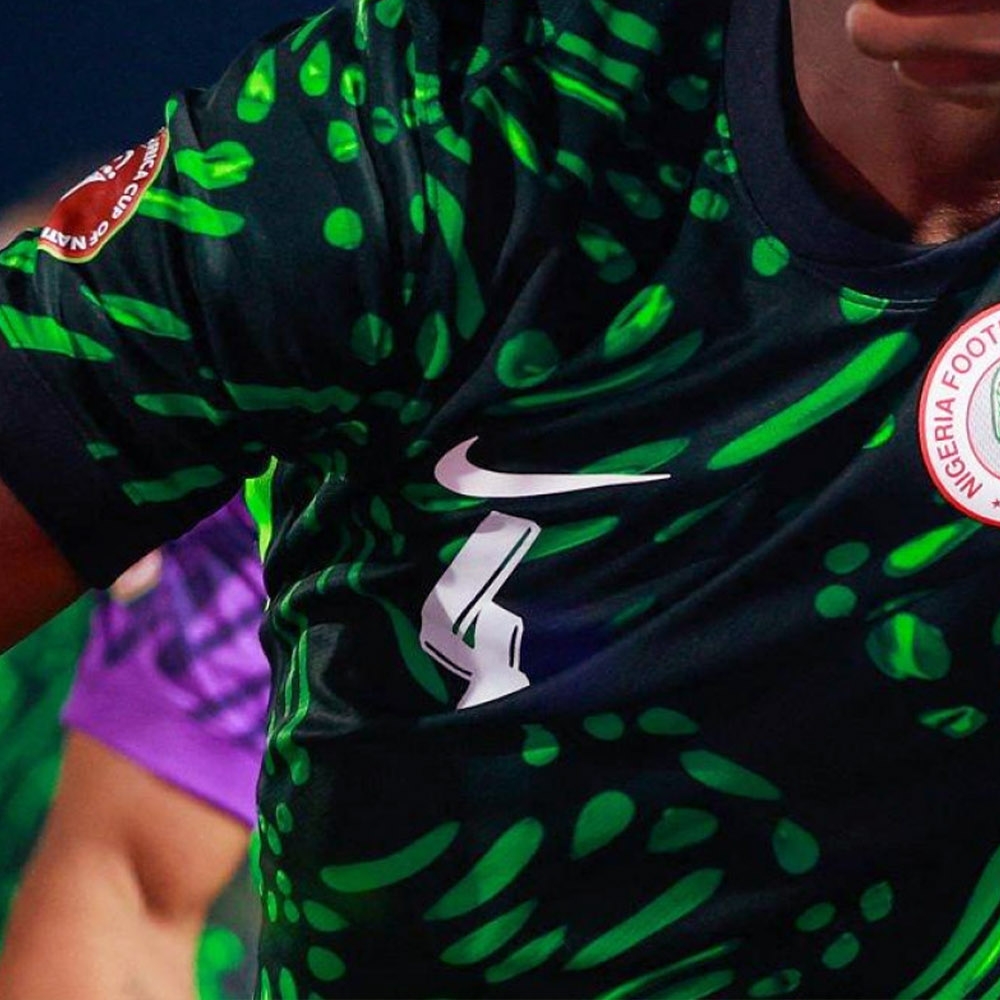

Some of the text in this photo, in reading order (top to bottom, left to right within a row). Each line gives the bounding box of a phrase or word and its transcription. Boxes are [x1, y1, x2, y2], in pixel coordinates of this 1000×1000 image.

[112, 183, 139, 219] CUP
[40, 226, 87, 250] NATI
[89, 220, 109, 246] OF
[935, 397, 984, 499] NIGERIA
